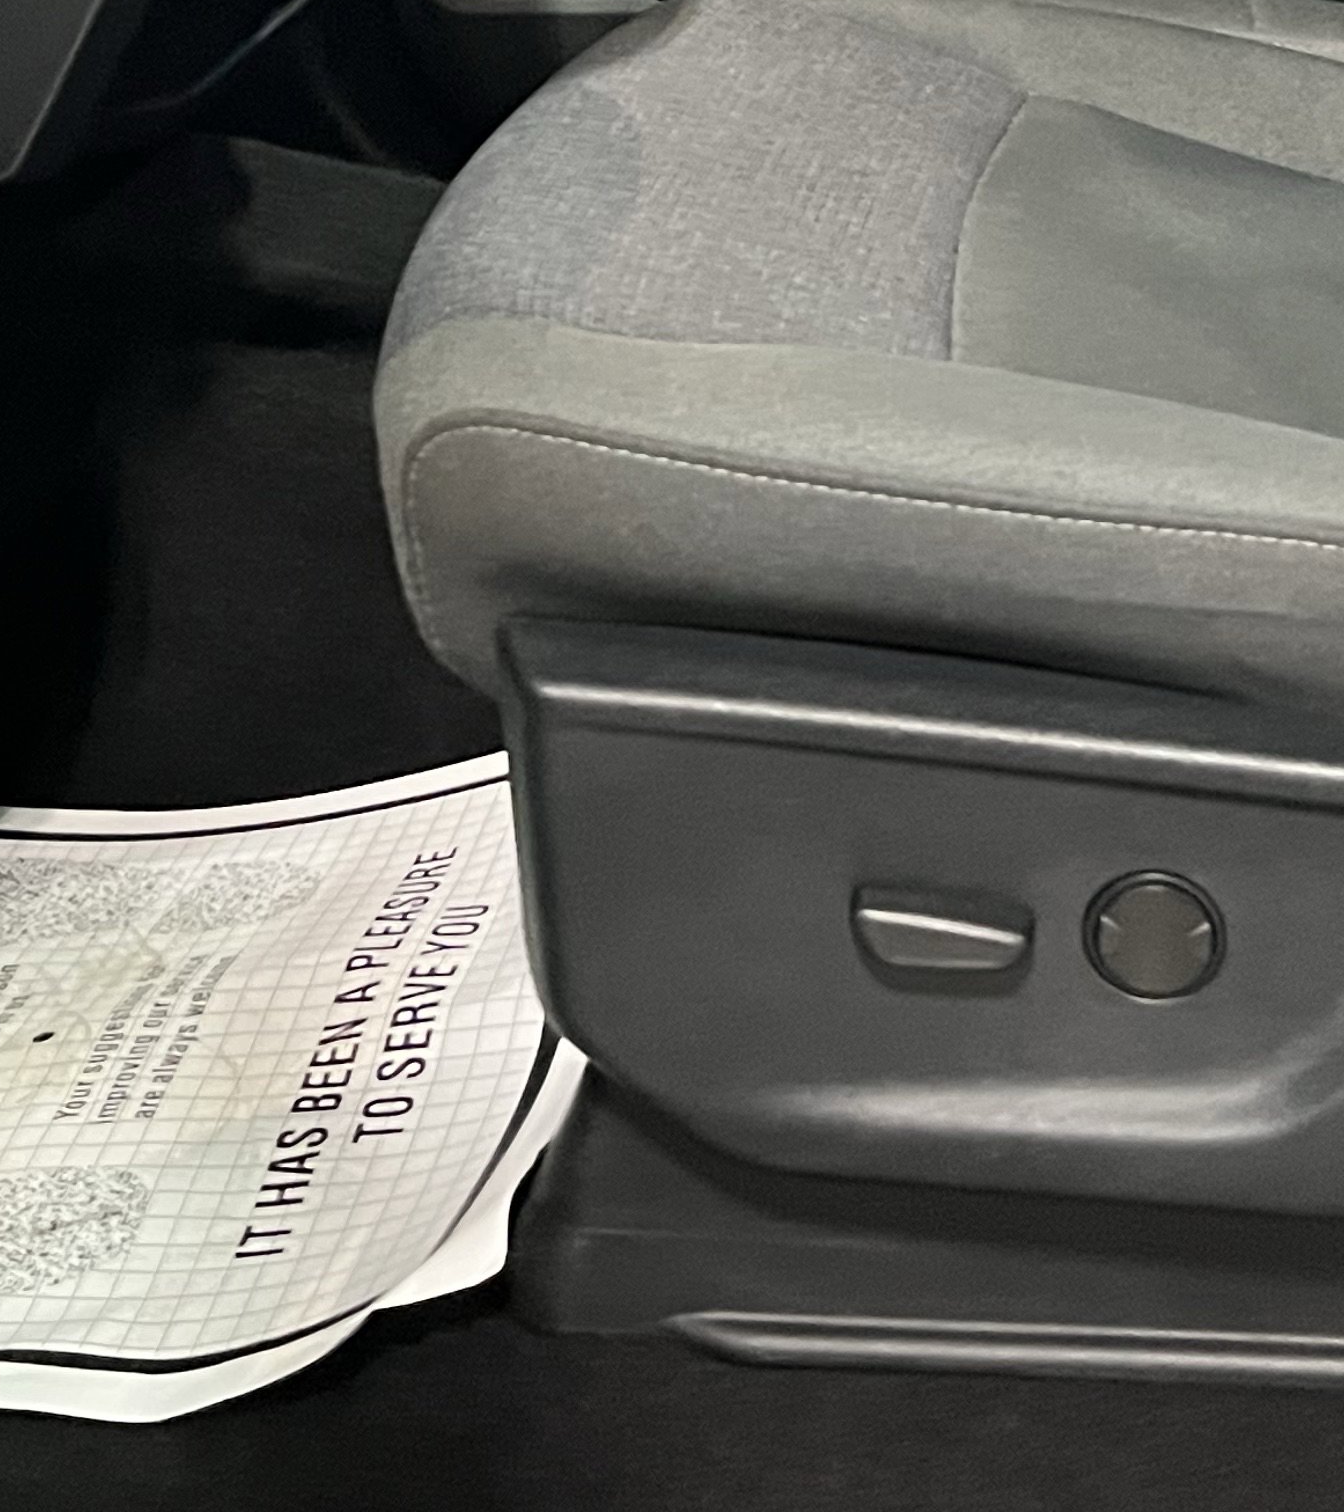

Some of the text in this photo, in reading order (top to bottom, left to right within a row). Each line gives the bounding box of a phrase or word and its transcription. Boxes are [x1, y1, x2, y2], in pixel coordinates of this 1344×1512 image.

[142, 1001, 172, 1028] our
[234, 846, 459, 1259] IT HAS BEEN A PLEASURE
[352, 904, 491, 1144] TO SERVE YOU
[52, 1080, 94, 1121] Your
[134, 1090, 165, 1119] are
[152, 1024, 199, 1083] always
